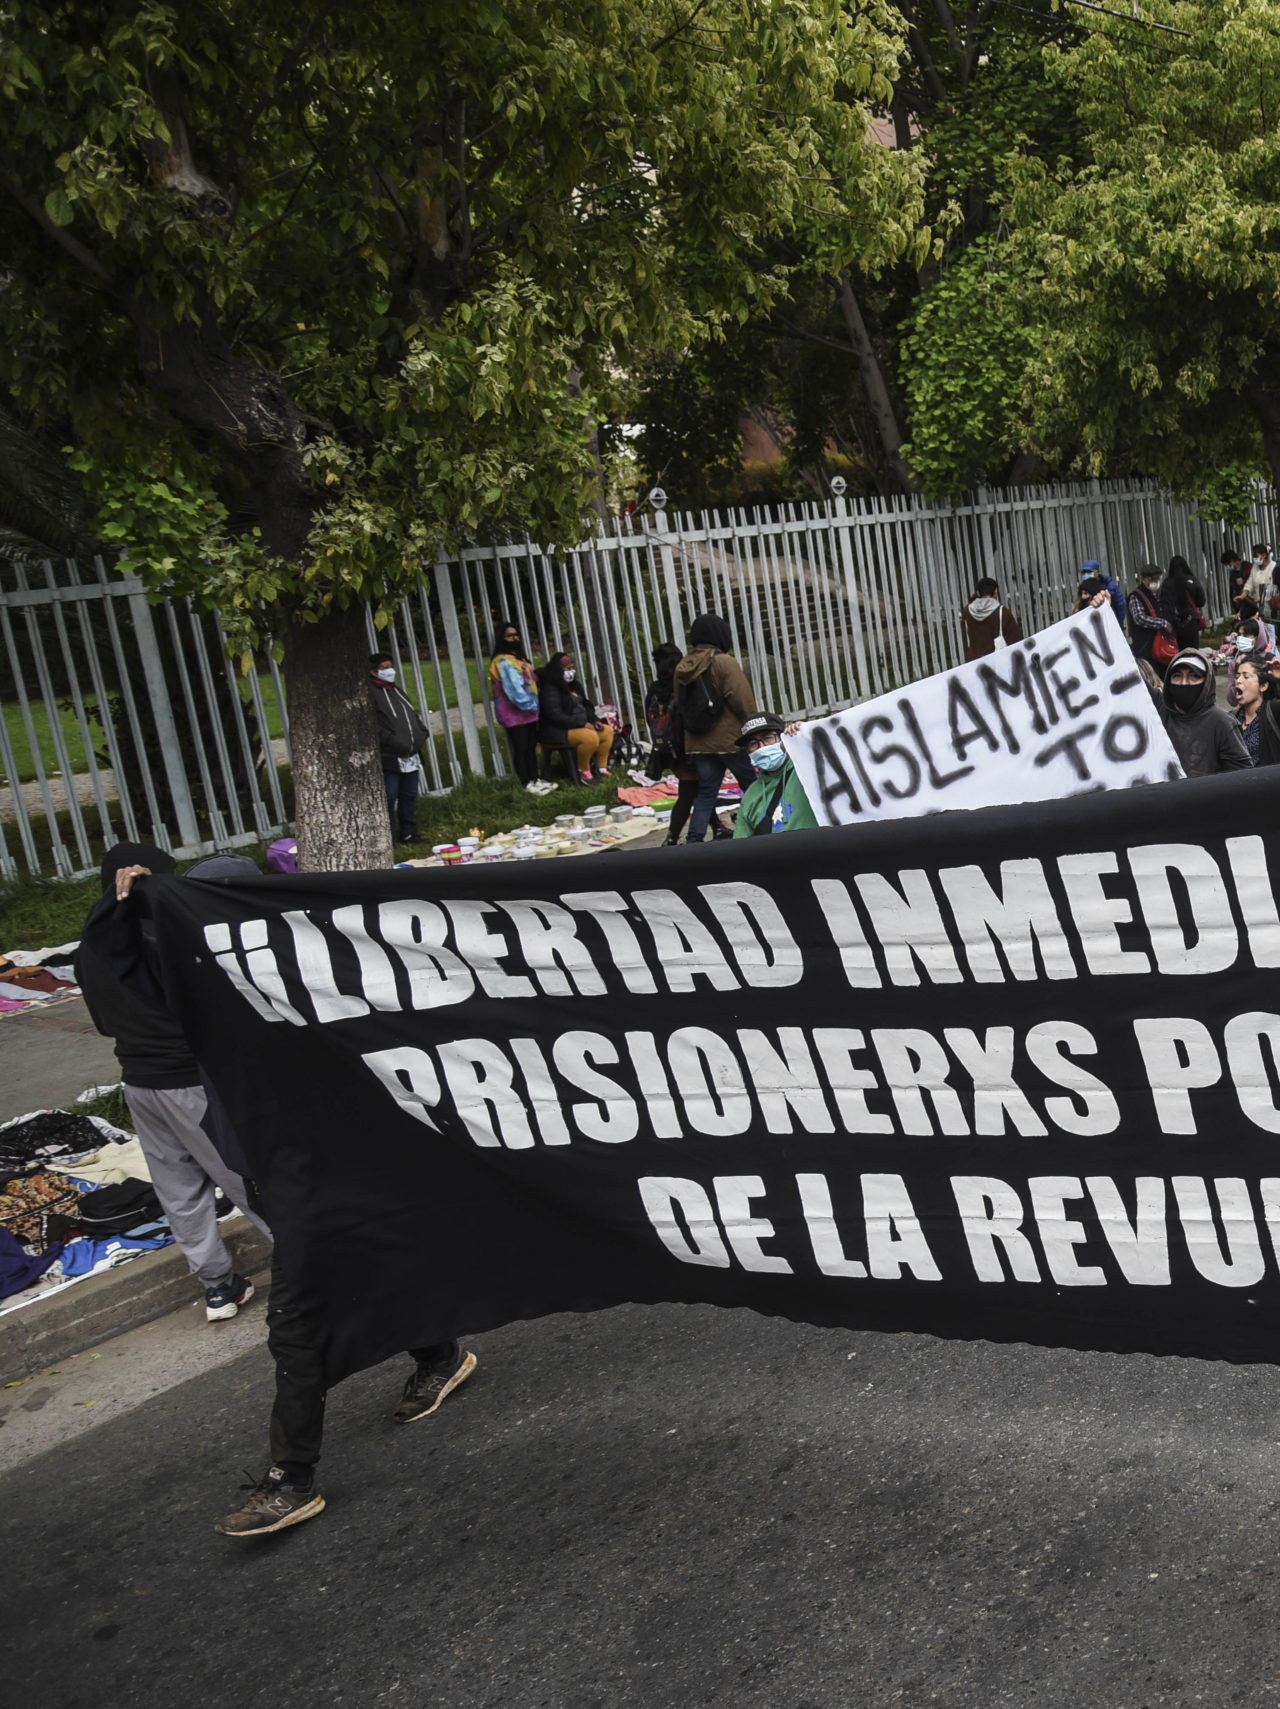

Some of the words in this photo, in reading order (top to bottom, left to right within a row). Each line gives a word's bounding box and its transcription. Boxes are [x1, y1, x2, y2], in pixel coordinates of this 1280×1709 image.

[1034, 714, 1148, 780] TO
[361, 1021, 1120, 1150] PRISIONERXS
[638, 1175, 795, 1274] DE
[795, 1173, 943, 1281] LA
